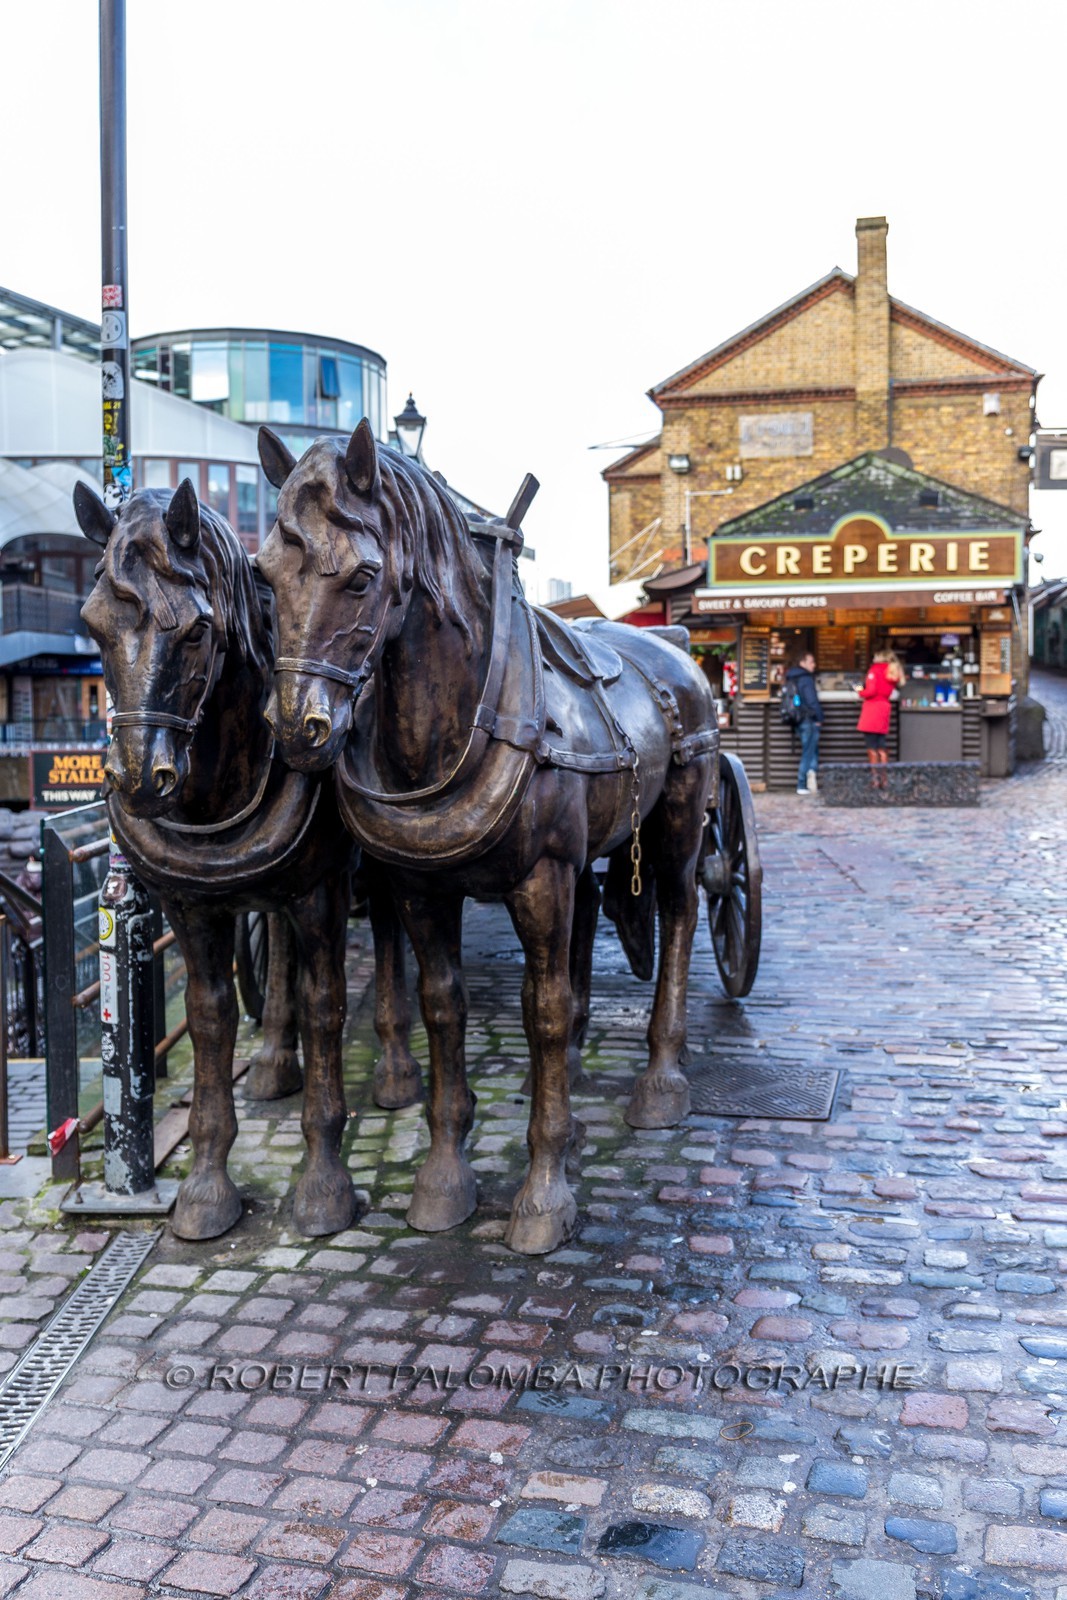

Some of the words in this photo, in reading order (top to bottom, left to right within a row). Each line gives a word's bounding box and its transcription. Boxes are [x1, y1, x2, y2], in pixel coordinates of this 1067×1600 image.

[740, 541, 990, 576] CREPERIE
[698, 599, 731, 610] SWEET
[743, 597, 787, 609] SAVOURY
[788, 596, 828, 608] CREPES
[934, 591, 974, 603] COFFEE
[975, 590, 997, 602] BAR
[53, 755, 102, 770] MORE
[48, 769, 105, 784] STALLS
[42, 790, 69, 801] THIS
[69, 790, 96, 801] WAY
